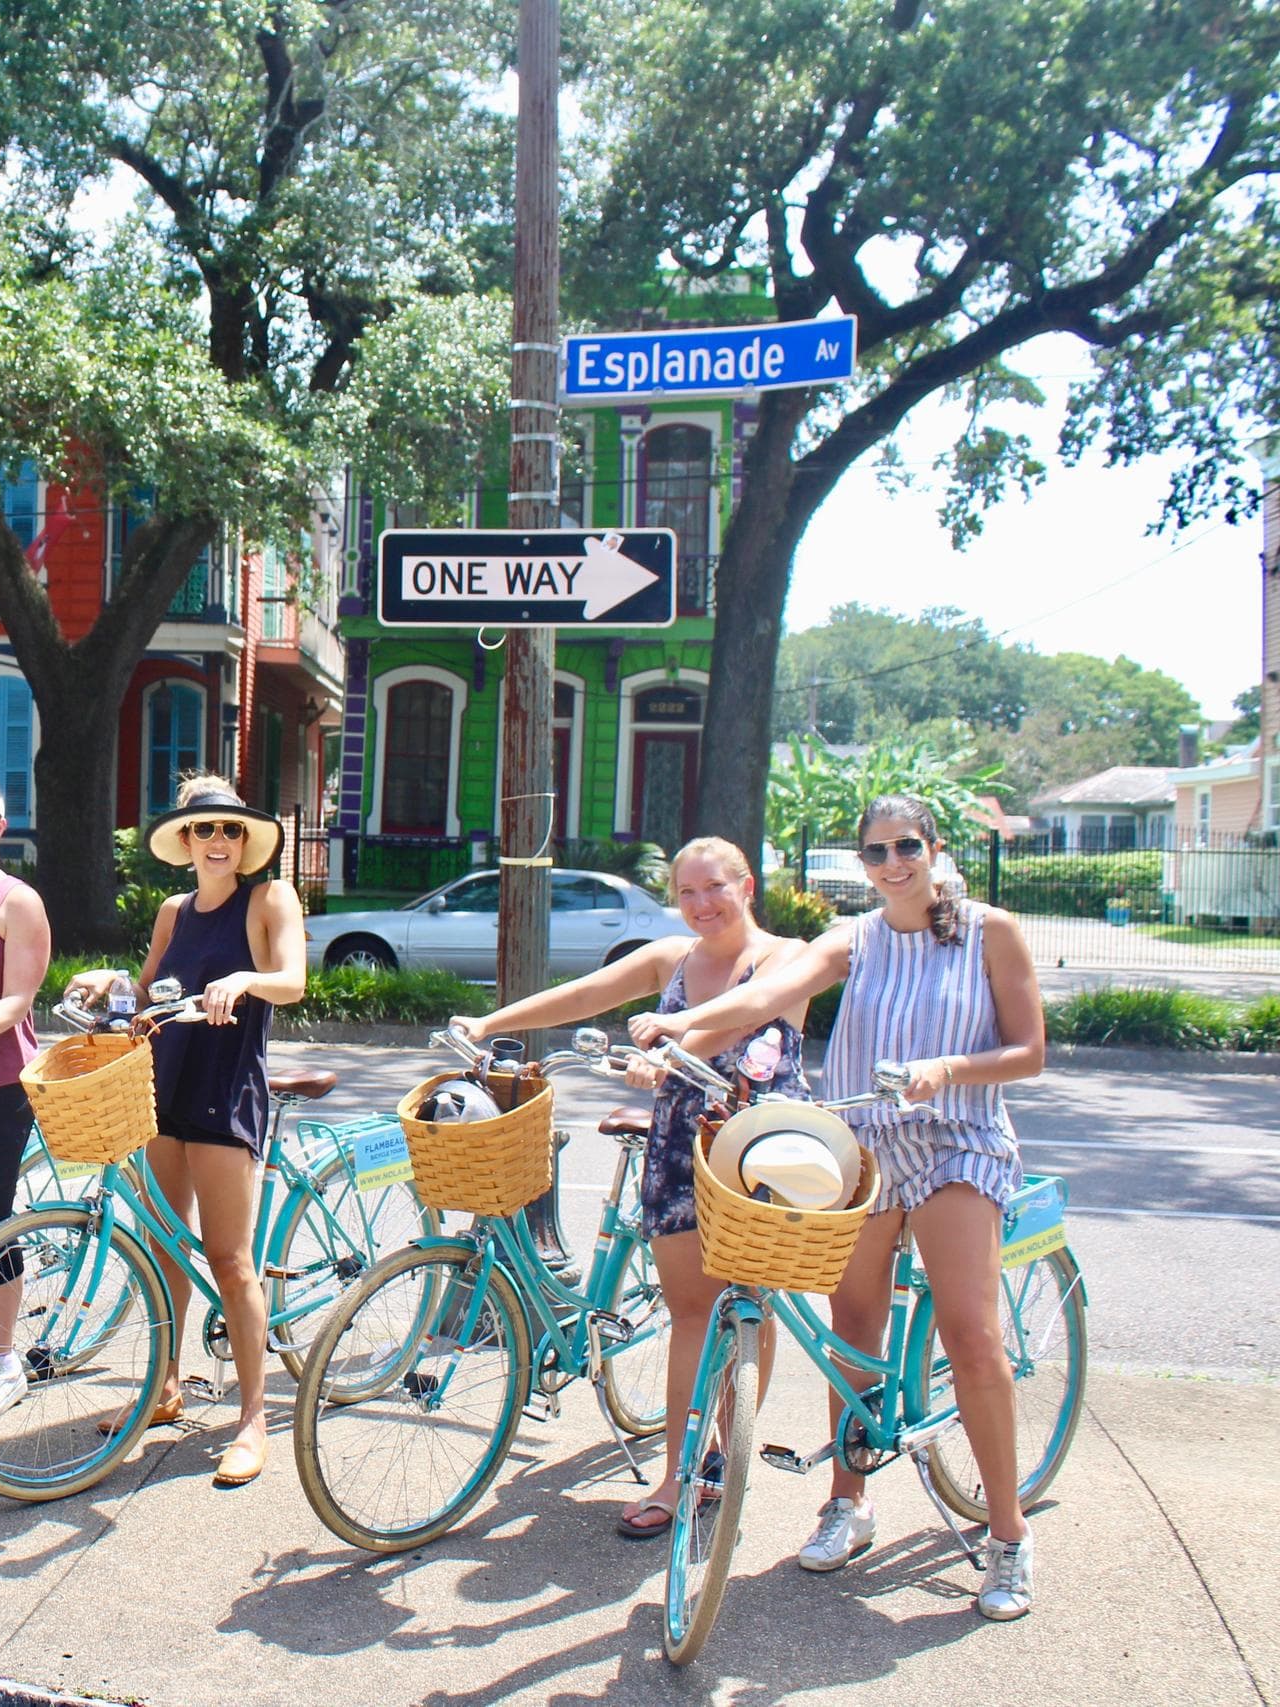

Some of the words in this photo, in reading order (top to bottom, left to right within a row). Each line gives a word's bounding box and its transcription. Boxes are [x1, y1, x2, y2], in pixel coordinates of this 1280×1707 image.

[578, 336, 785, 392] Esplanade
[815, 338, 840, 362] Av
[412, 561, 488, 595] ONE
[504, 561, 583, 595] WAY
